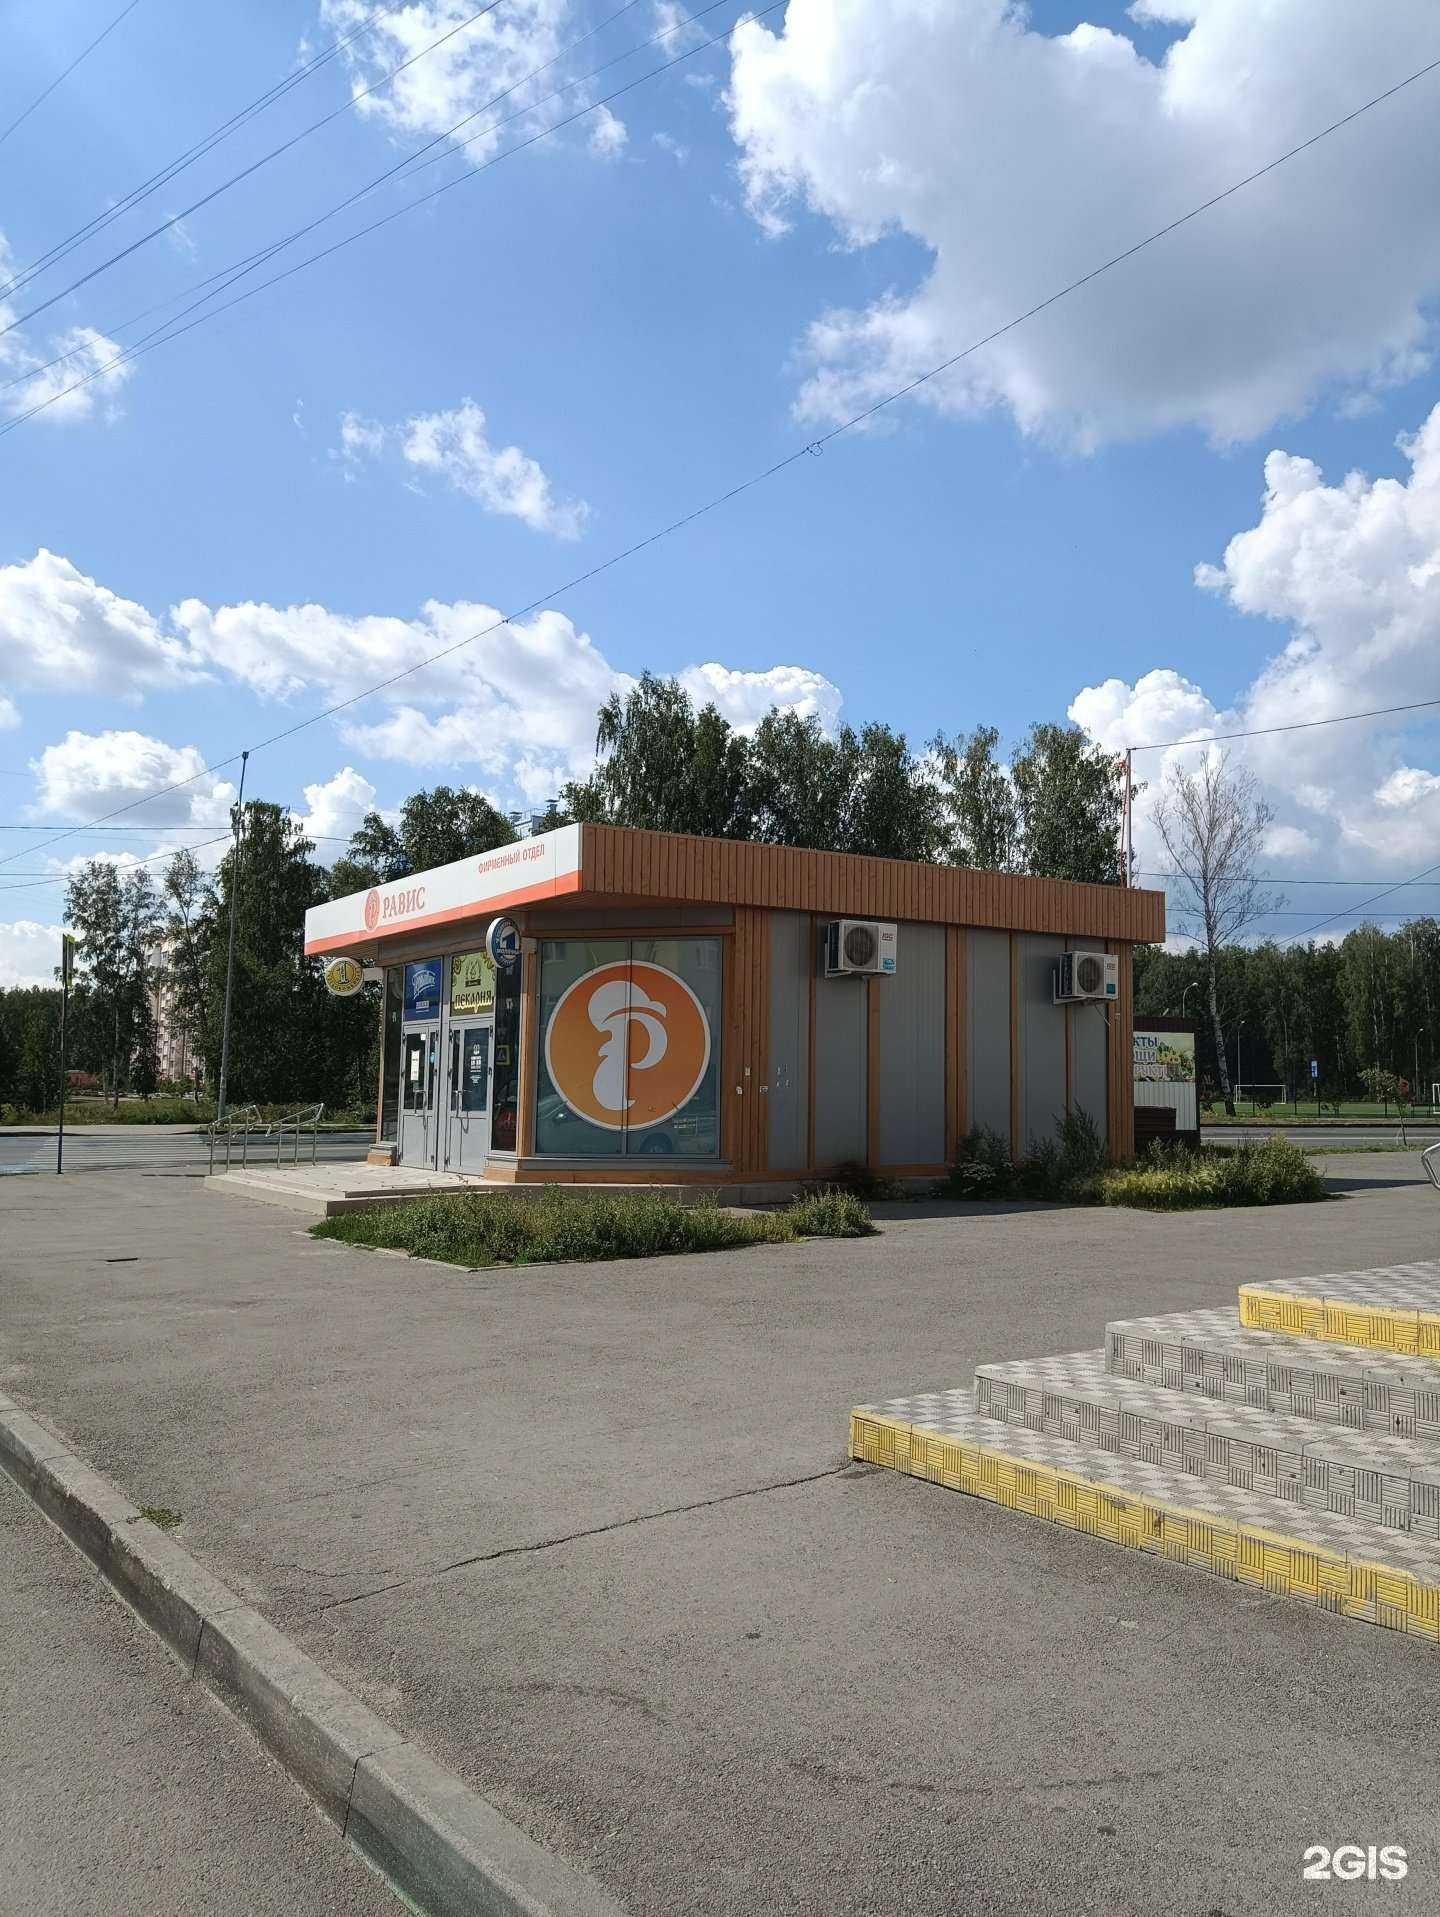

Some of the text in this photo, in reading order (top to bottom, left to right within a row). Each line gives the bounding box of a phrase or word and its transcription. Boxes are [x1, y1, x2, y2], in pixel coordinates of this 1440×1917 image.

[478, 844, 545, 874] ФИРМЕННЫЙ ОТДЕЛ
[382, 887, 426, 918] РАВИС
[1133, 1050, 1156, 1062] ЩИ
